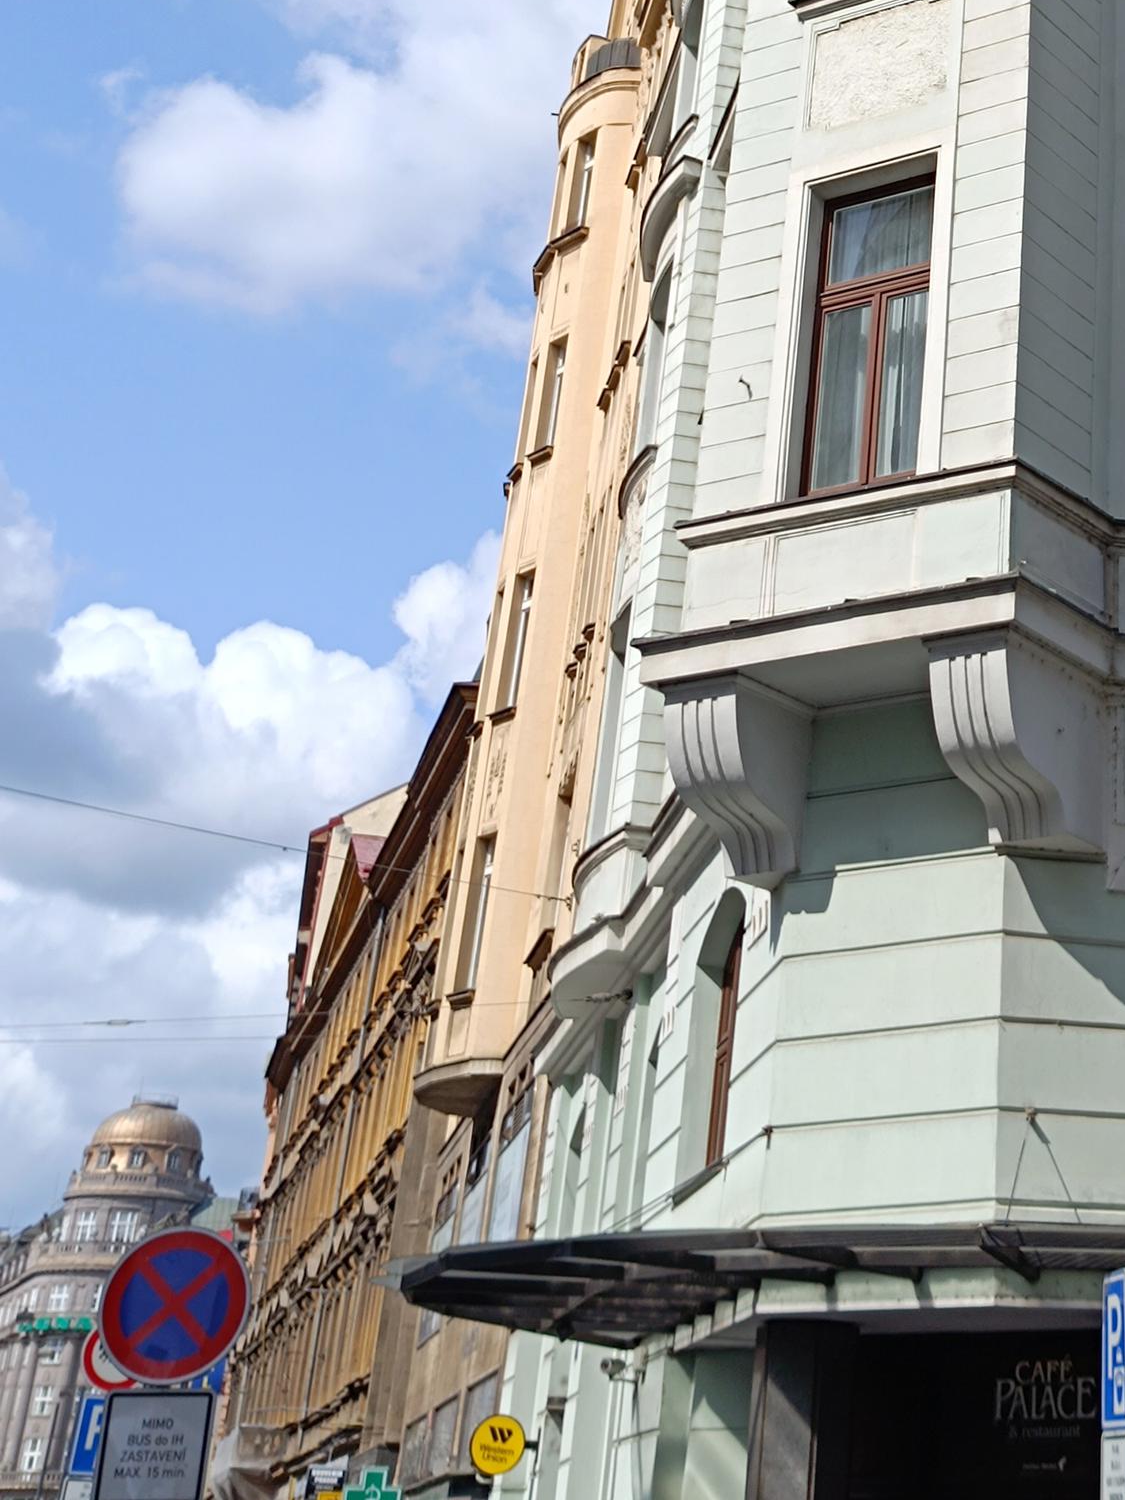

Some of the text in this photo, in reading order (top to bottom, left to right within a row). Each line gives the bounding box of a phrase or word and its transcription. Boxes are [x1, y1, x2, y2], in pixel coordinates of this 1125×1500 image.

[1107, 1293, 1123, 1380] P
[1015, 1353, 1073, 1384] CAFÉ
[993, 1376, 1097, 1420] PALACE
[142, 1418, 174, 1430] MIMO
[1022, 1424, 1081, 1437] restaurant
[127, 1434, 151, 1446] BUS
[155, 1435, 168, 1446] do
[120, 1447, 187, 1462] ZASTAVENÍ
[480, 1443, 515, 1457] Western
[148, 1467, 159, 1478] 15
